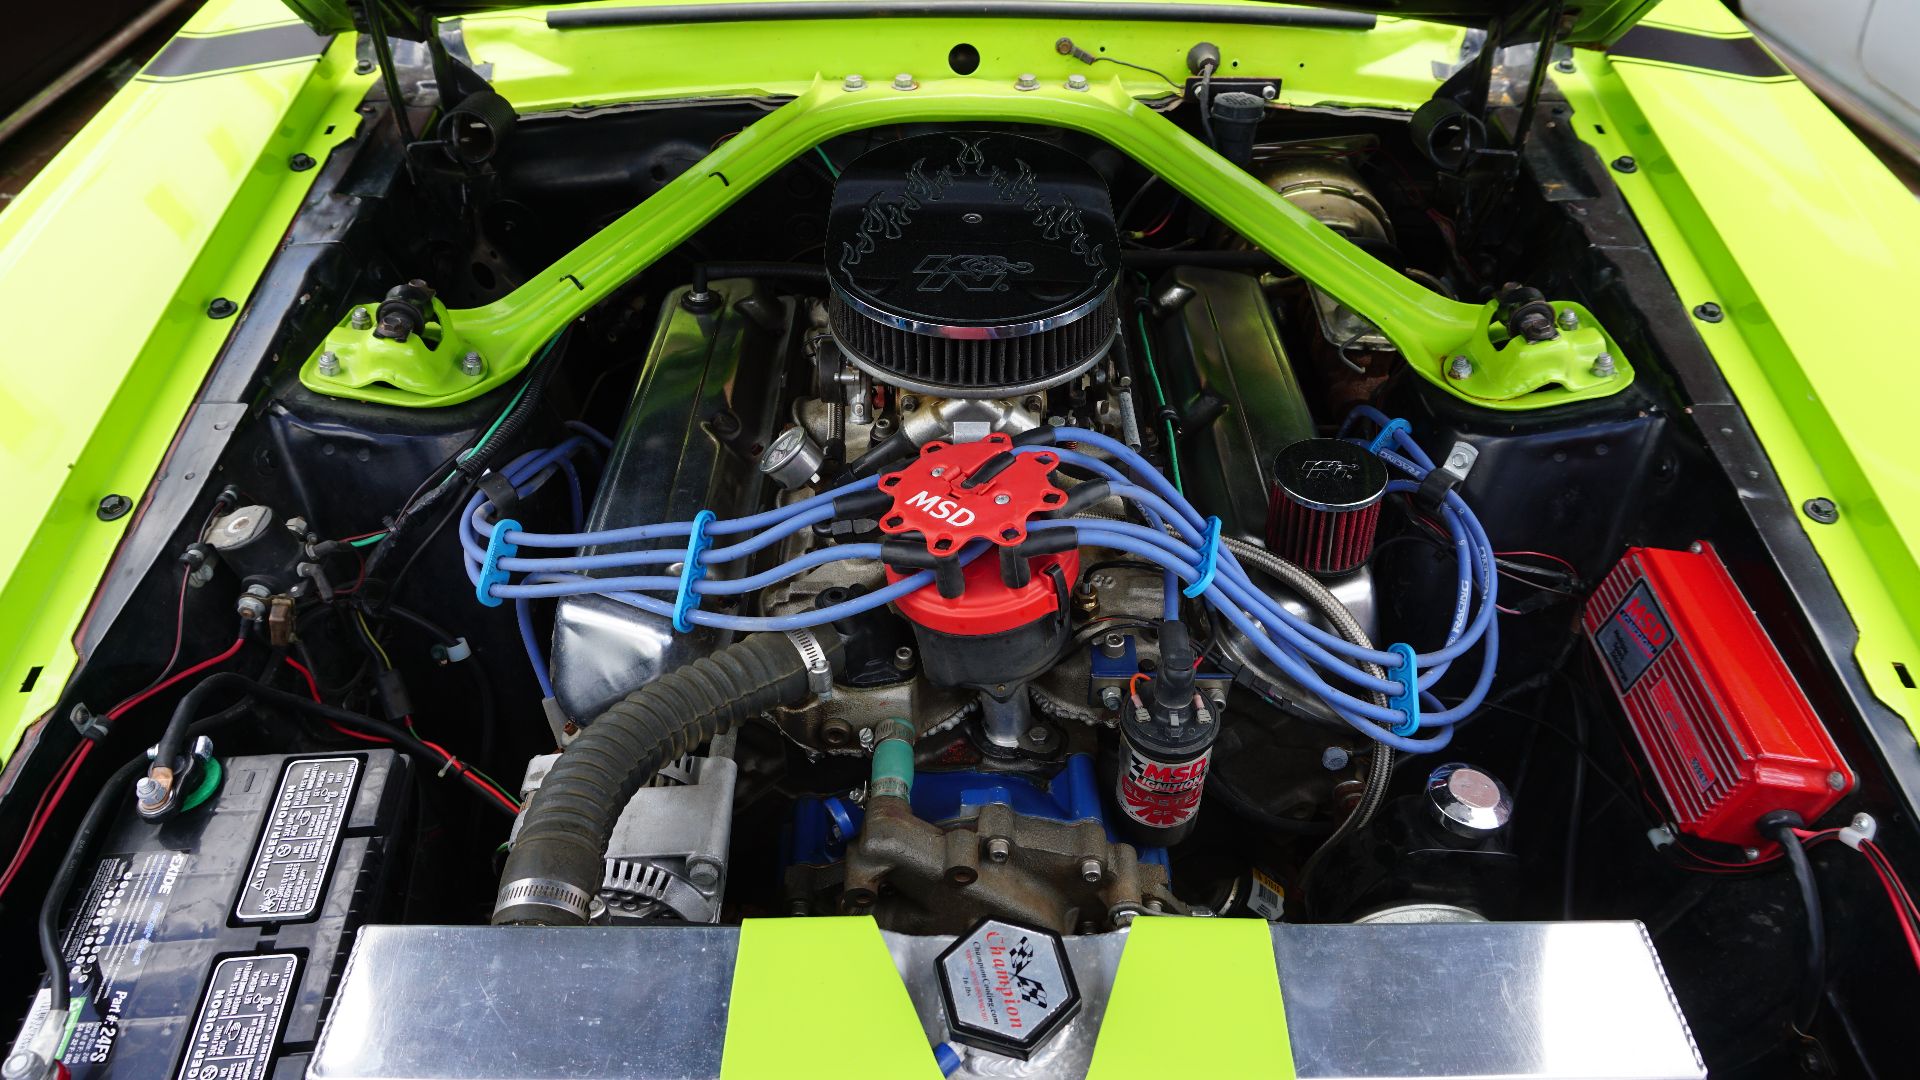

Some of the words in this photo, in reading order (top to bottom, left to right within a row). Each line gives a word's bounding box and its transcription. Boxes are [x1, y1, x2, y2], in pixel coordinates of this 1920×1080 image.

[1380, 450, 1422, 478] RACING
[905, 491, 975, 527] MSD
[1453, 580, 1469, 633] RACING
[1624, 596, 1666, 646] MSD
[1143, 757, 1207, 783] MSD
[1141, 775, 1205, 792] IGNITION
[255, 784, 297, 878] DANGER/POISON
[157, 855, 184, 894] EXIDE
[276, 878, 289, 897] SHIELD
[283, 863, 293, 876] EYES
[278, 882, 294, 910] EXPLOSIVE
[288, 862, 300, 880] GASES
[232, 967, 243, 981] WITH
[247, 969, 261, 992] MEDICAL
[259, 972, 271, 986] HELP
[269, 972, 280, 985] FAST
[973, 941, 999, 1025] ChampionCooling.com
[986, 931, 1023, 1029] Champion
[227, 982, 238, 996] EYES
[243, 993, 254, 1004] GET
[108, 990, 128, 1012] Part
[221, 997, 233, 1015] FLUSH
[89, 1021, 102, 1037] Group
[103, 1014, 119, 1024] #:
[85, 1038, 95, 1051] Size:
[88, 1026, 117, 1062] 24FS
[207, 1025, 224, 1055] SULFURIC
[238, 1026, 249, 1043] CAUSE
[216, 1039, 228, 1055] ACID
[234, 1044, 243, 1055] CAN
